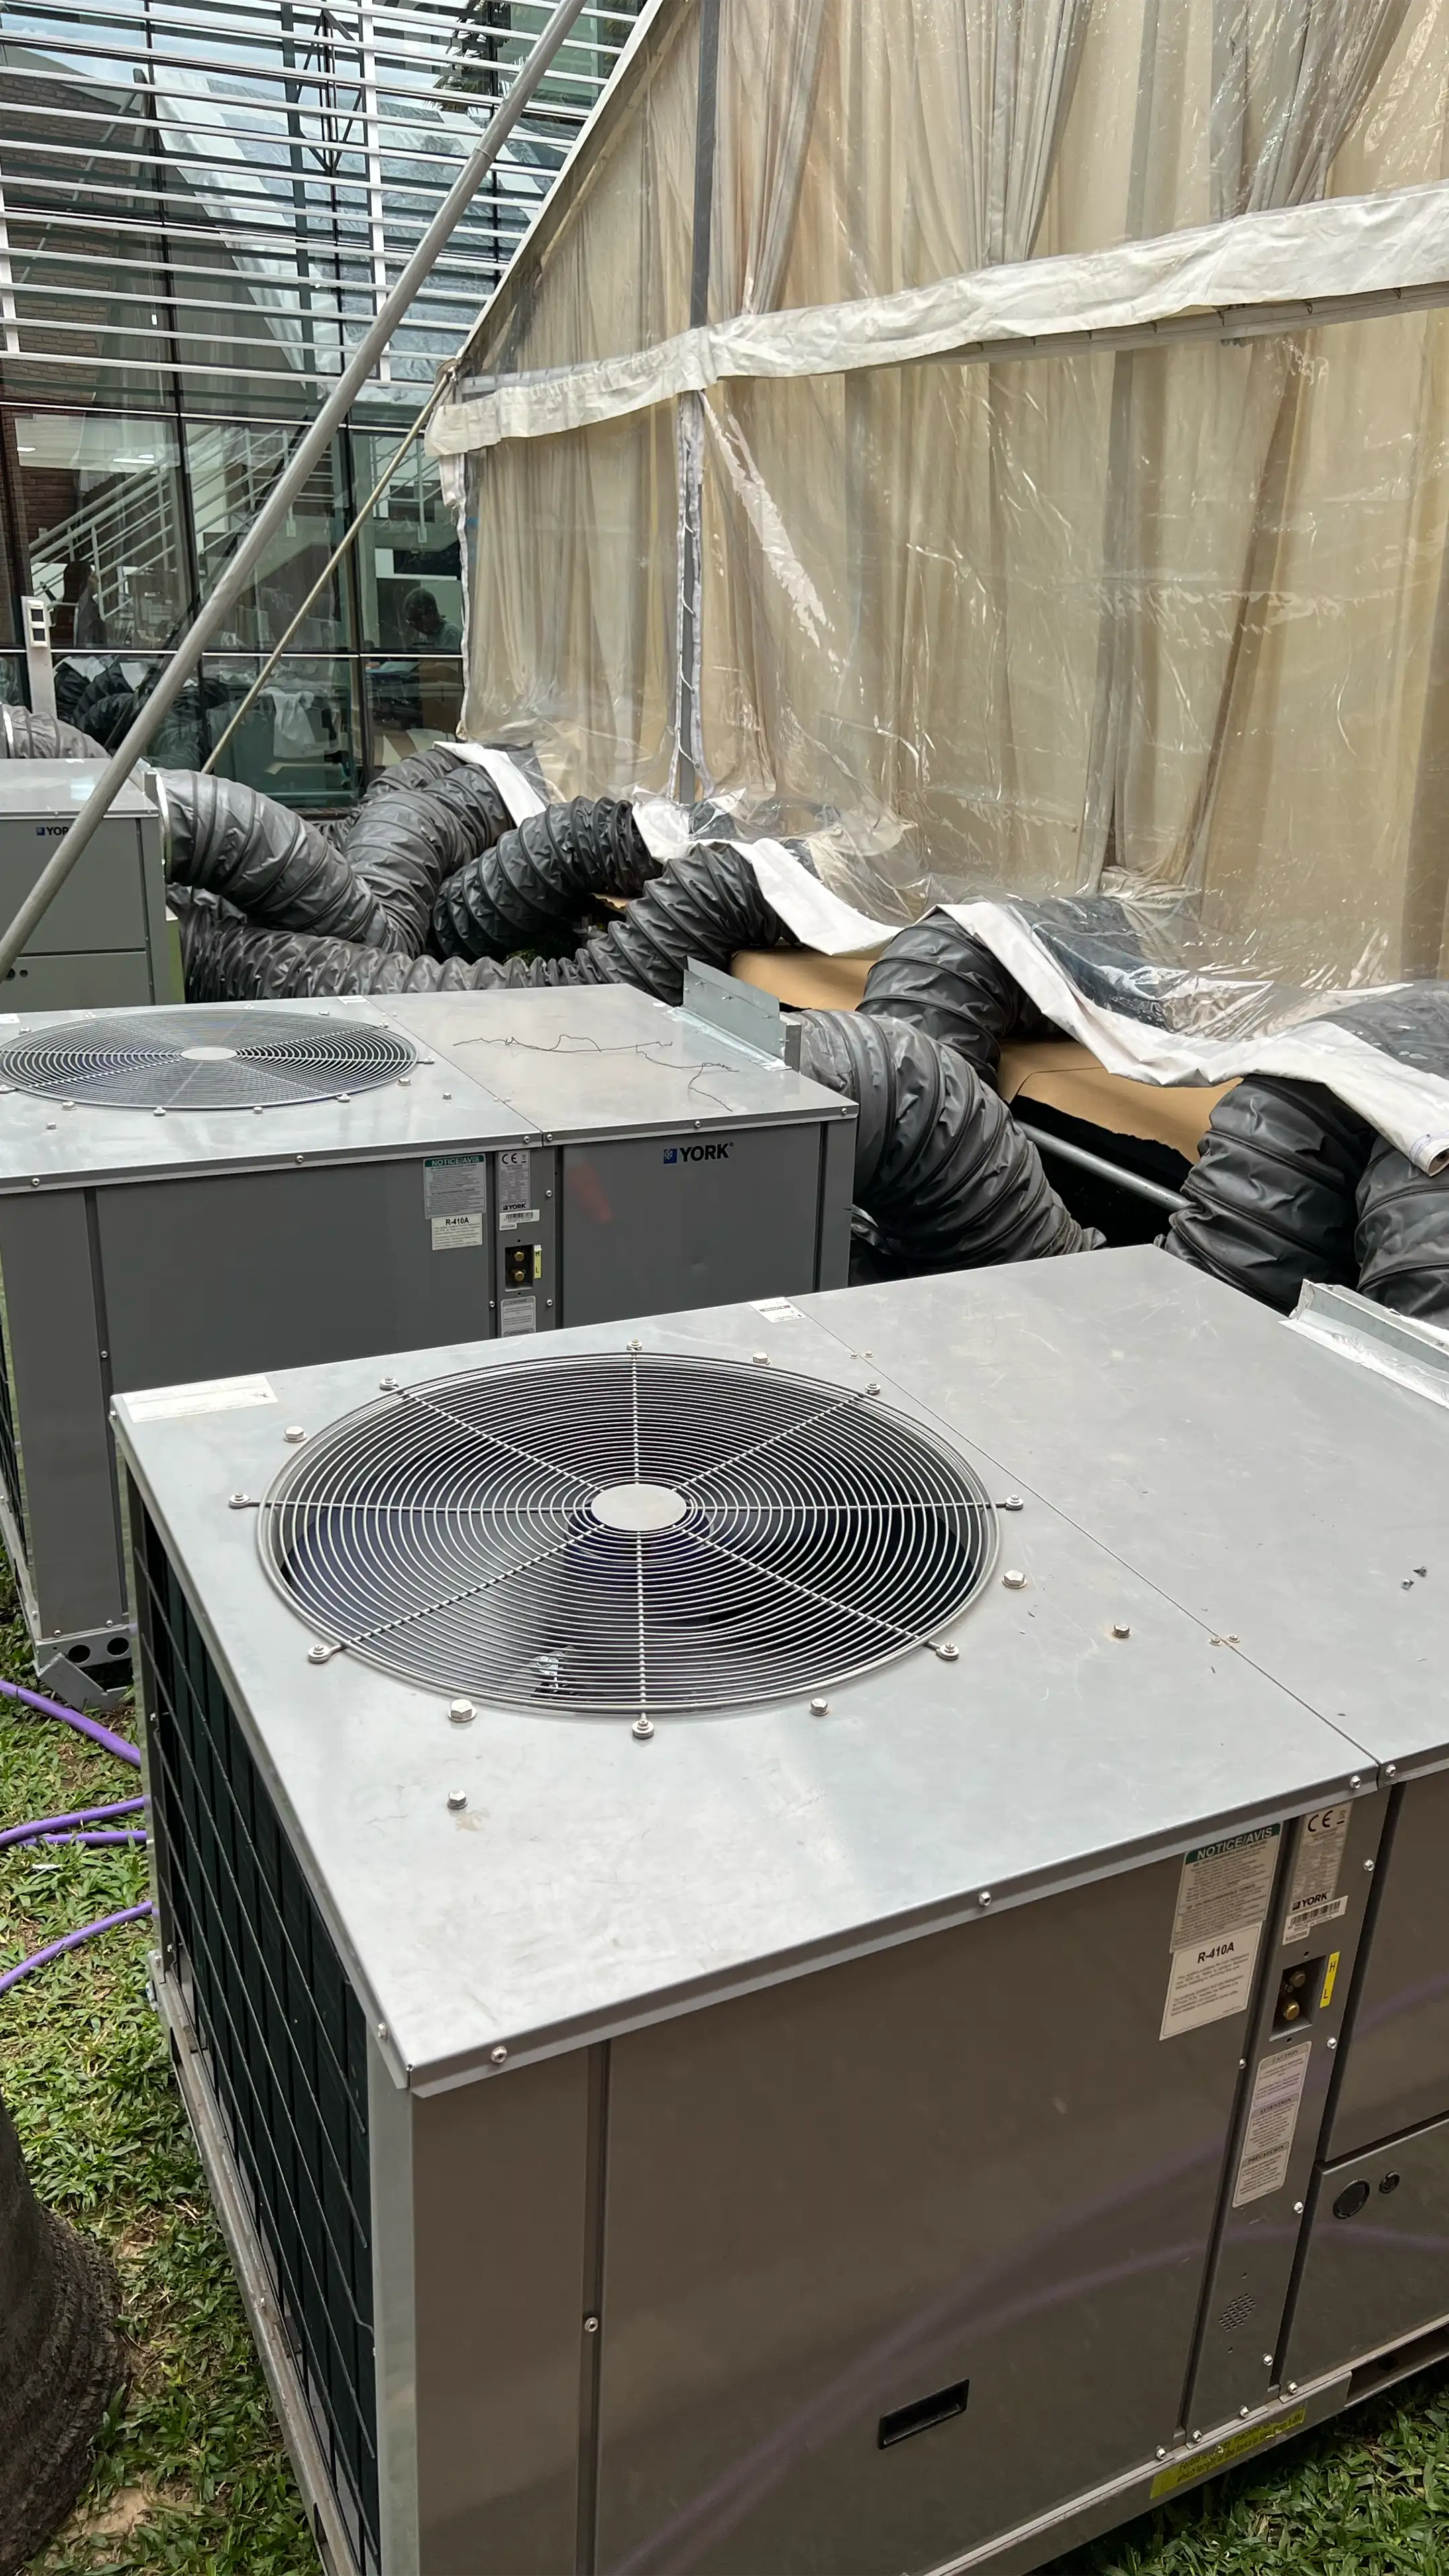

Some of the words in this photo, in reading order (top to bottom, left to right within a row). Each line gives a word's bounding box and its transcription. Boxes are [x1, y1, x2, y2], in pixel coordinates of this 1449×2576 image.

[46, 826, 70, 836] YOR
[680, 1143, 730, 1162] YORK
[431, 1156, 480, 1167] NOTICE/AVIS
[445, 1218, 470, 1226] R-410A
[1196, 1827, 1273, 1860] NOTICE/AVIS
[1301, 1892, 1328, 1908] YORK
[1197, 1942, 1234, 1963] R-410A
[1329, 1960, 1336, 1972] H
[1323, 1988, 1328, 1999] L
